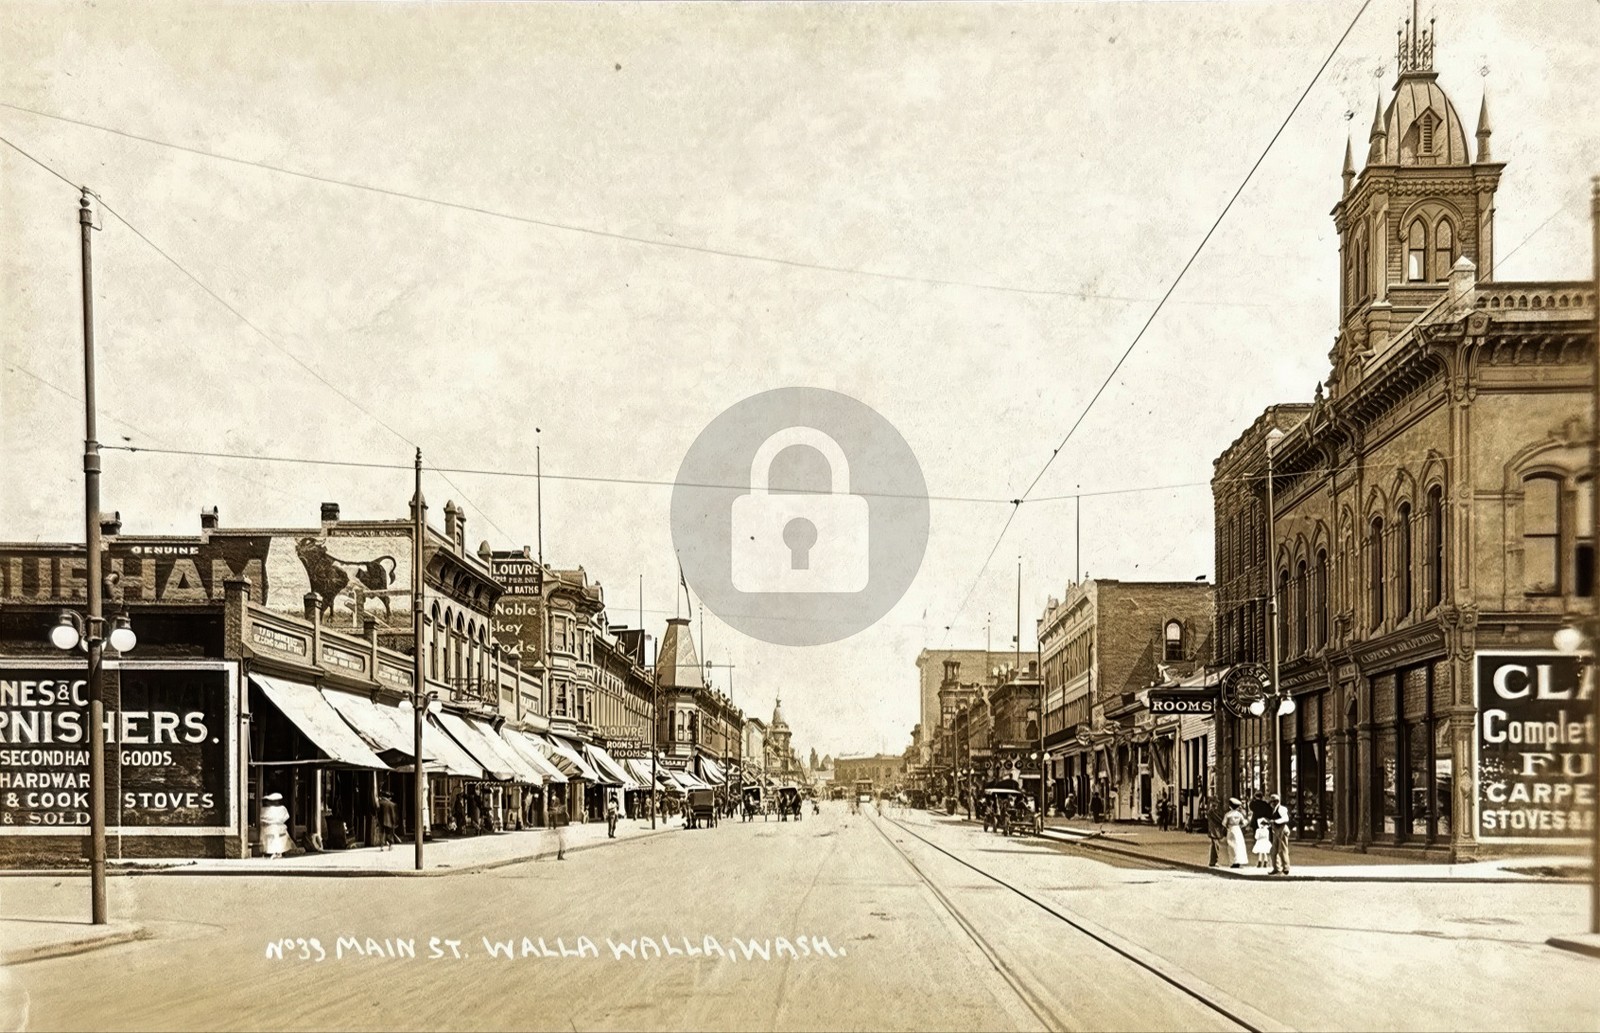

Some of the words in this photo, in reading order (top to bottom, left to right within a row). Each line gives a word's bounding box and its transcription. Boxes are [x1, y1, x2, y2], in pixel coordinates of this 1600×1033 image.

[131, 546, 199, 555] GENUINE
[493, 564, 540, 575] LOUVRE
[0, 557, 263, 605] URHAM
[514, 586, 540, 594] BATHS
[495, 603, 537, 616] Noble
[1152, 701, 1213, 711] ROOMS
[605, 726, 644, 737] LOUVRE
[606, 740, 634, 749] ROOMS
[121, 750, 177, 766] GOODS.
[613, 749, 647, 758] ROOMS
[0, 772, 91, 788] HARDWAR
[1486, 782, 1595, 805] CARPE
[6, 792, 20, 808] &
[27, 792, 90, 808] COOK
[124, 792, 214, 809] STOVES
[3, 812, 14, 824] &
[28, 811, 92, 825] SOLD
